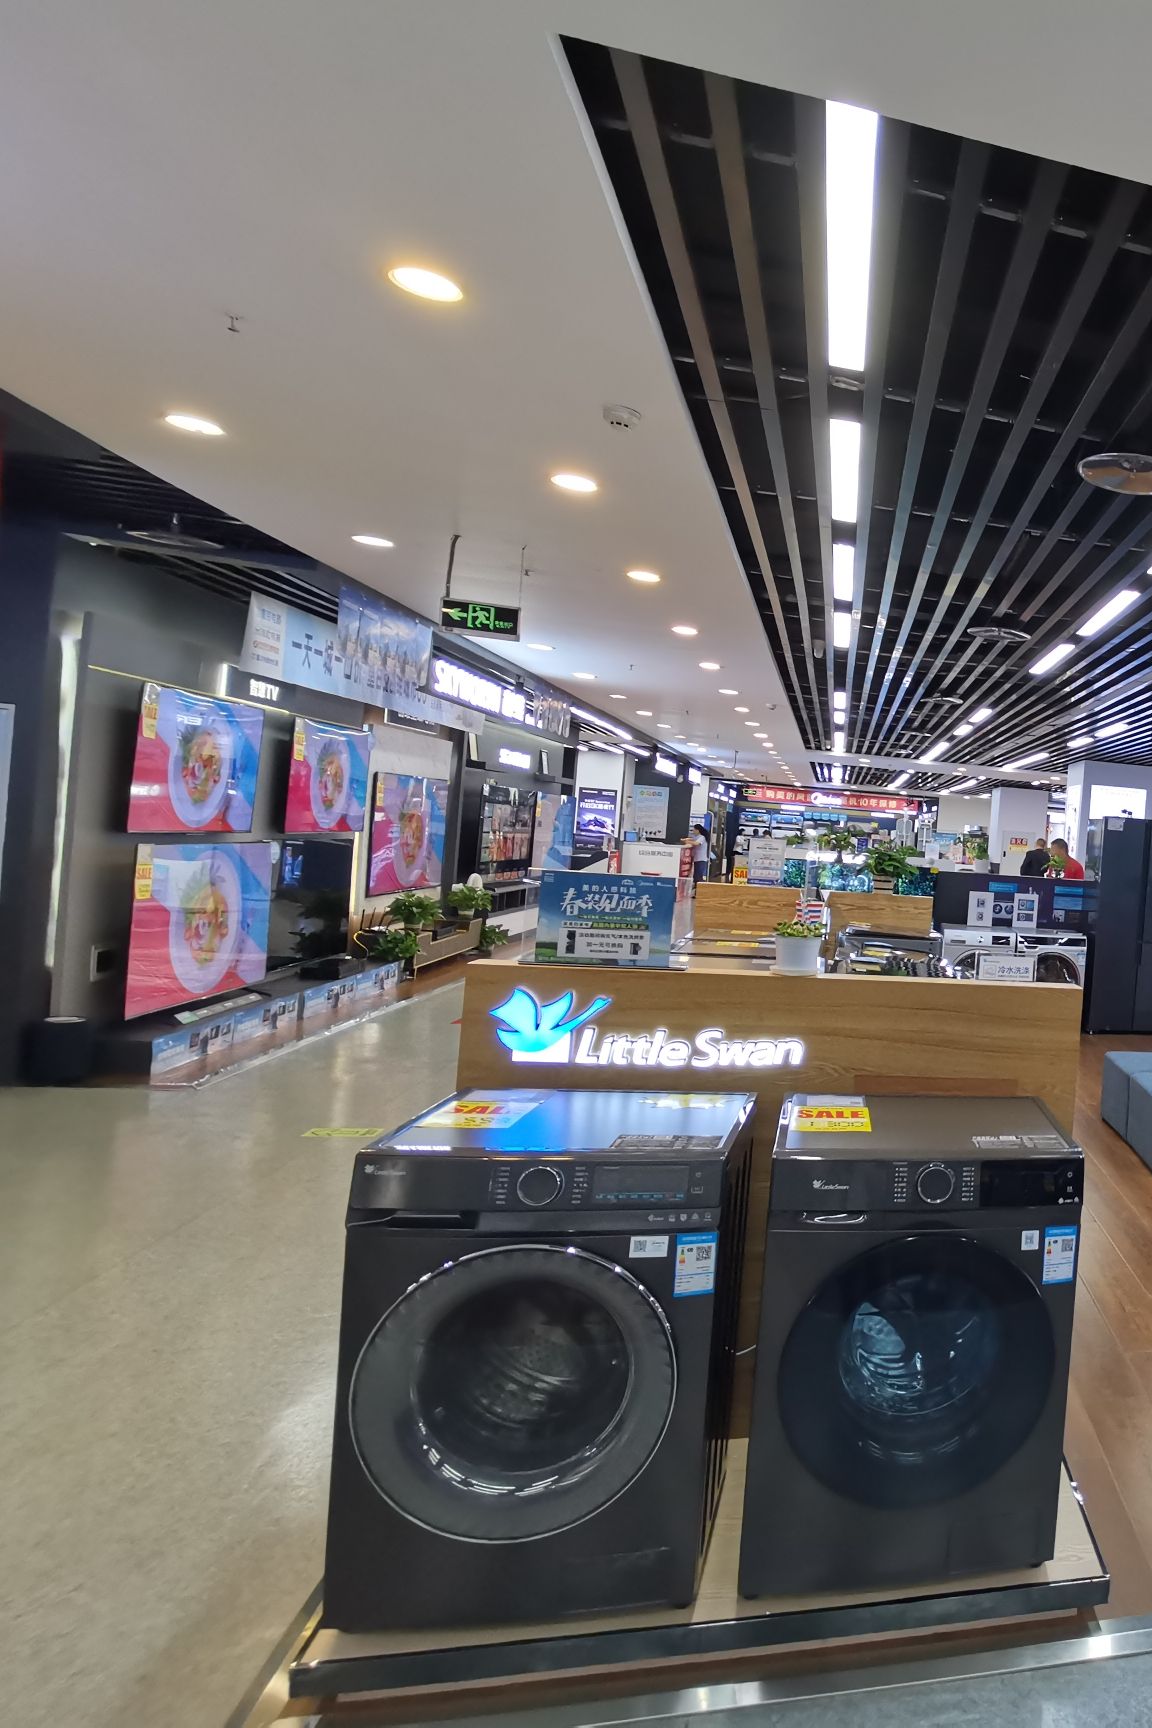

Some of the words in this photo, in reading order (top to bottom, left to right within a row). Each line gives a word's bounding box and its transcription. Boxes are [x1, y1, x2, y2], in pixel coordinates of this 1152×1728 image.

[574, 1027, 691, 1067] Little
[692, 1028, 804, 1067] Swan
[797, 1109, 865, 1119] SALE
